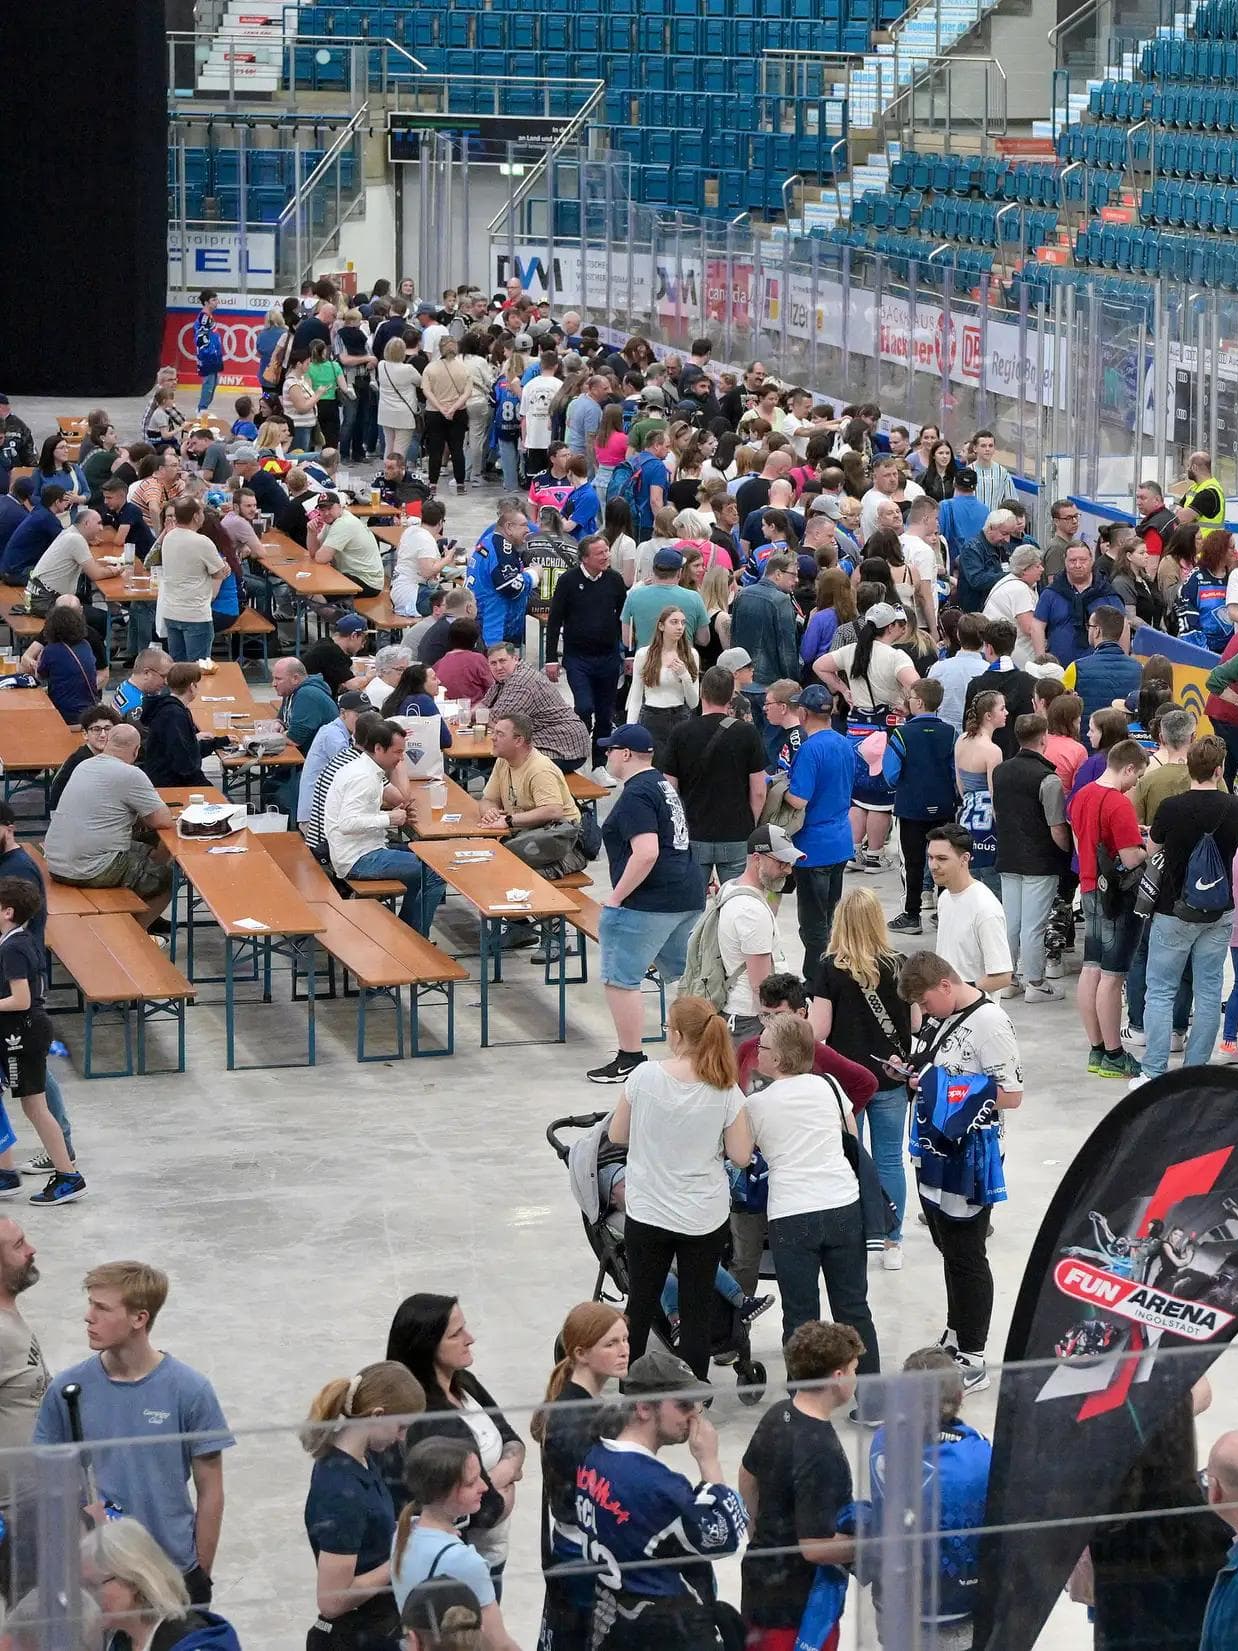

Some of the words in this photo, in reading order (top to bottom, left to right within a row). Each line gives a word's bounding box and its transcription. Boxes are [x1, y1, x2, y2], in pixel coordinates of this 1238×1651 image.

[1063, 1266, 1122, 1302] FUN
[1127, 1288, 1225, 1332] ARENA
[1134, 1308, 1201, 1336] INGOLSTADT
